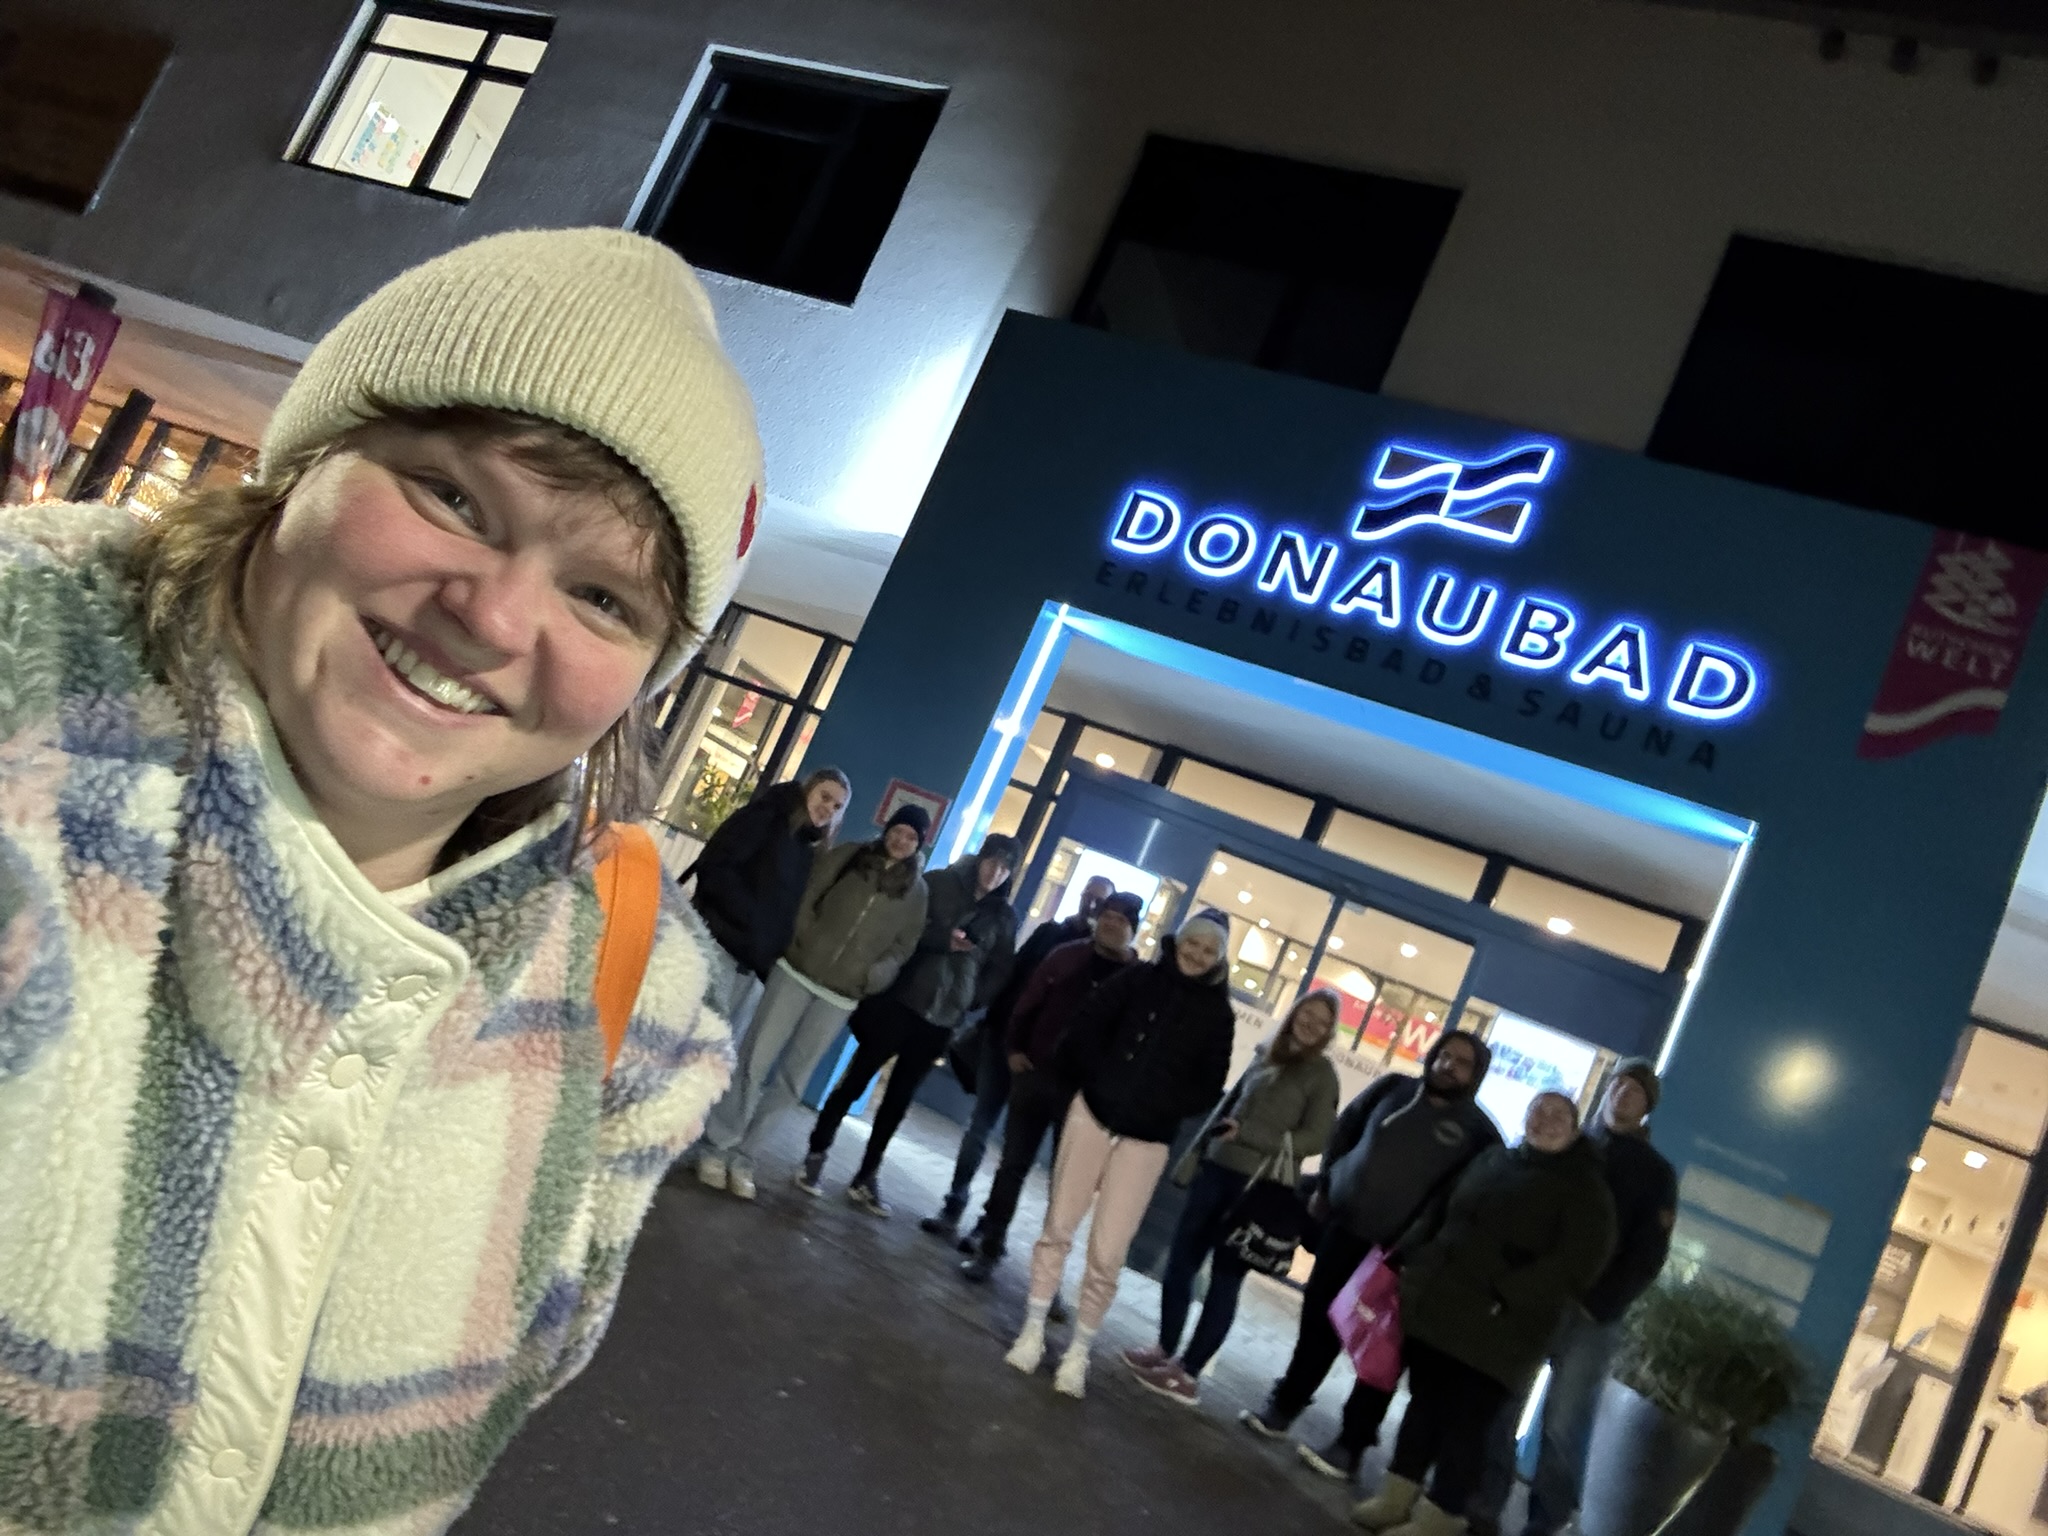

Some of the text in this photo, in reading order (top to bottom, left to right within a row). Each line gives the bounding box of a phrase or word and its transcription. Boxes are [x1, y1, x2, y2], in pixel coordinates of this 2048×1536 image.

[1095, 560, 1717, 771] ERLEBNISBAD & SAUNA
[1109, 488, 1758, 721] DONAUBAD
